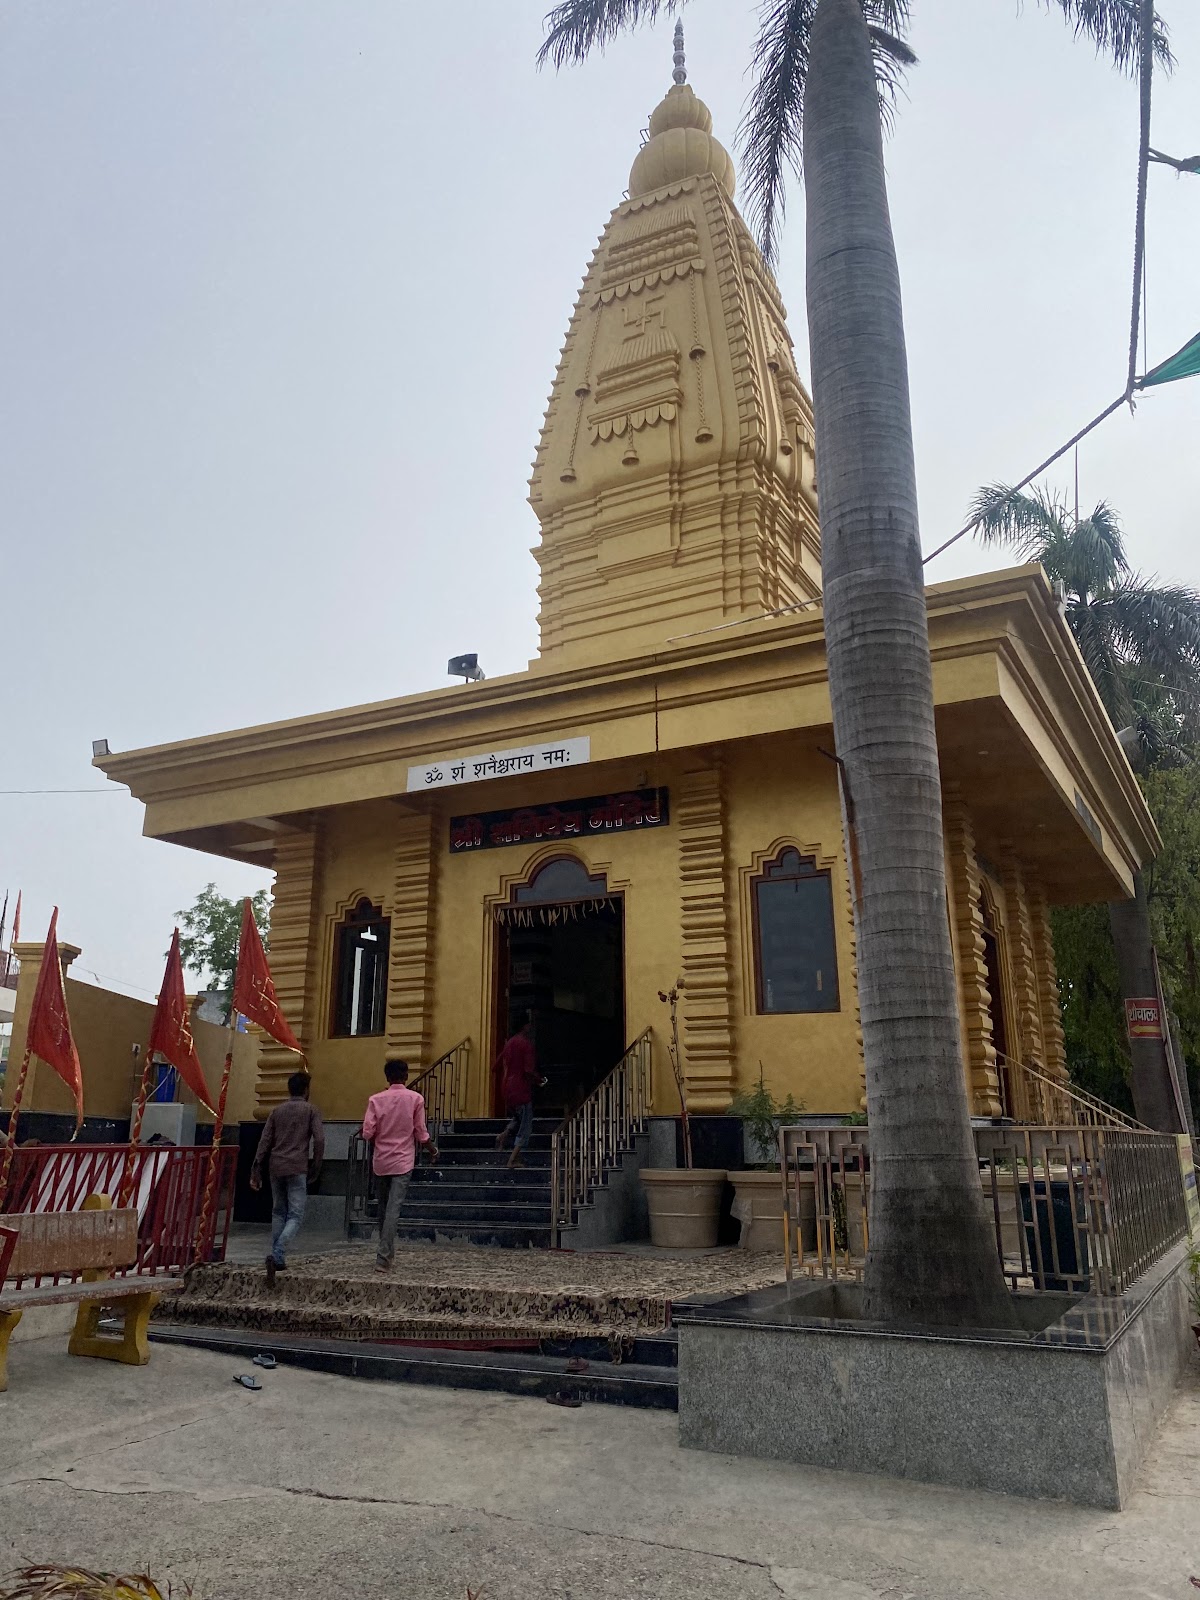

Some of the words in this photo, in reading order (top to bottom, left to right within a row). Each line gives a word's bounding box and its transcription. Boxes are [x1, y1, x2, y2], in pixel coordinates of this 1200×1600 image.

[425, 767, 443, 784] ॐ
[451, 762, 466, 782] शं
[542, 749, 571, 765] नमः
